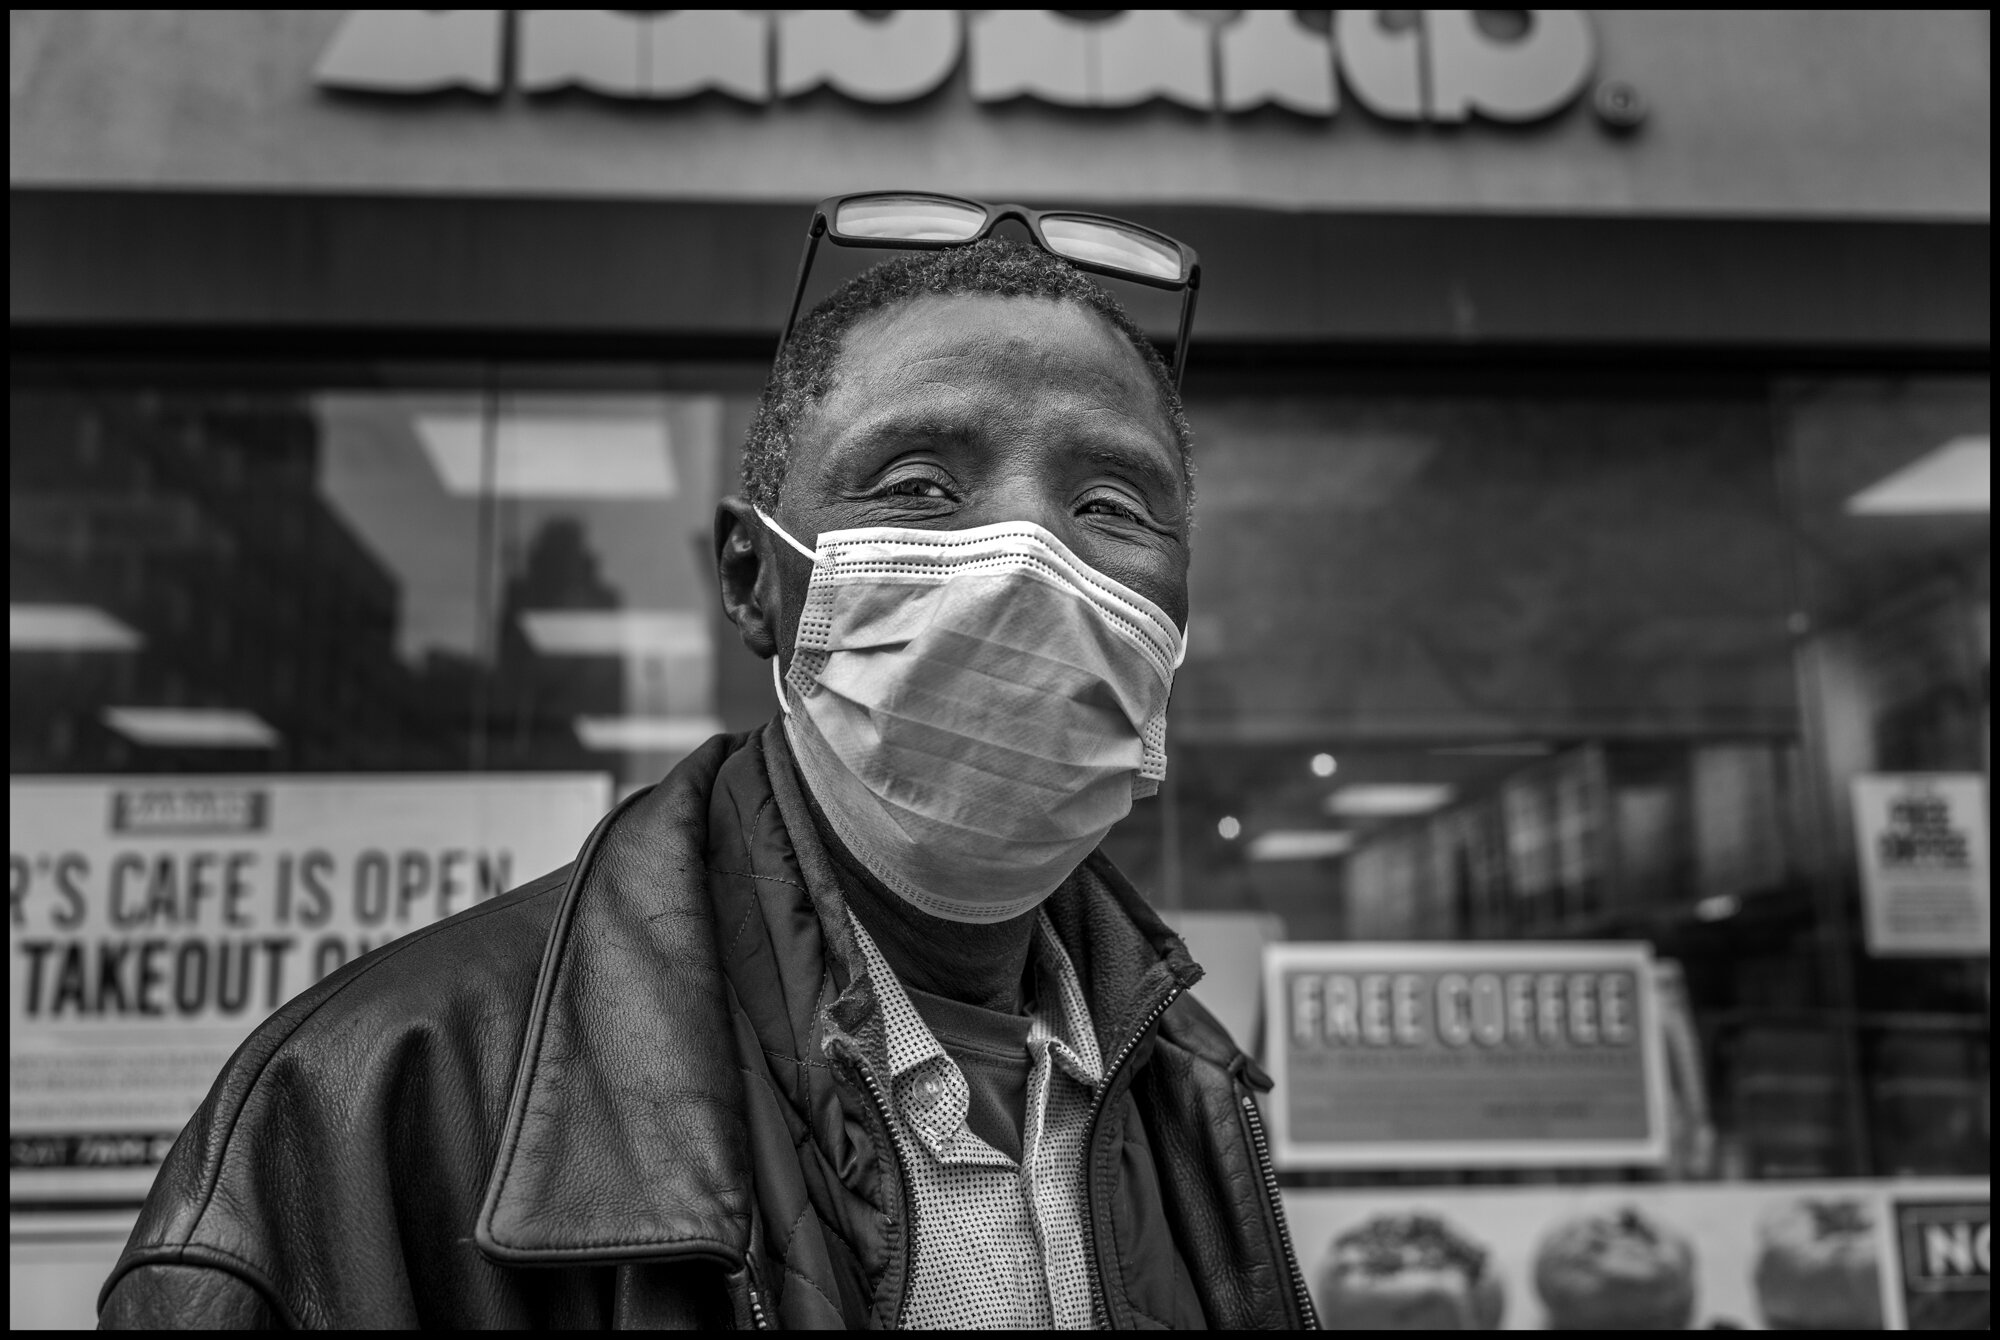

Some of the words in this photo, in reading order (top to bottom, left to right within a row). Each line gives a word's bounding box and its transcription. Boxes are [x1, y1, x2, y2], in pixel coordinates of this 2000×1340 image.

[109, 852, 256, 928] CAFE
[274, 851, 336, 928] IS
[22, 937, 297, 1018] TAKEOUT
[1291, 973, 1423, 1046] FREE
[1436, 973, 1634, 1046] COFFEE
